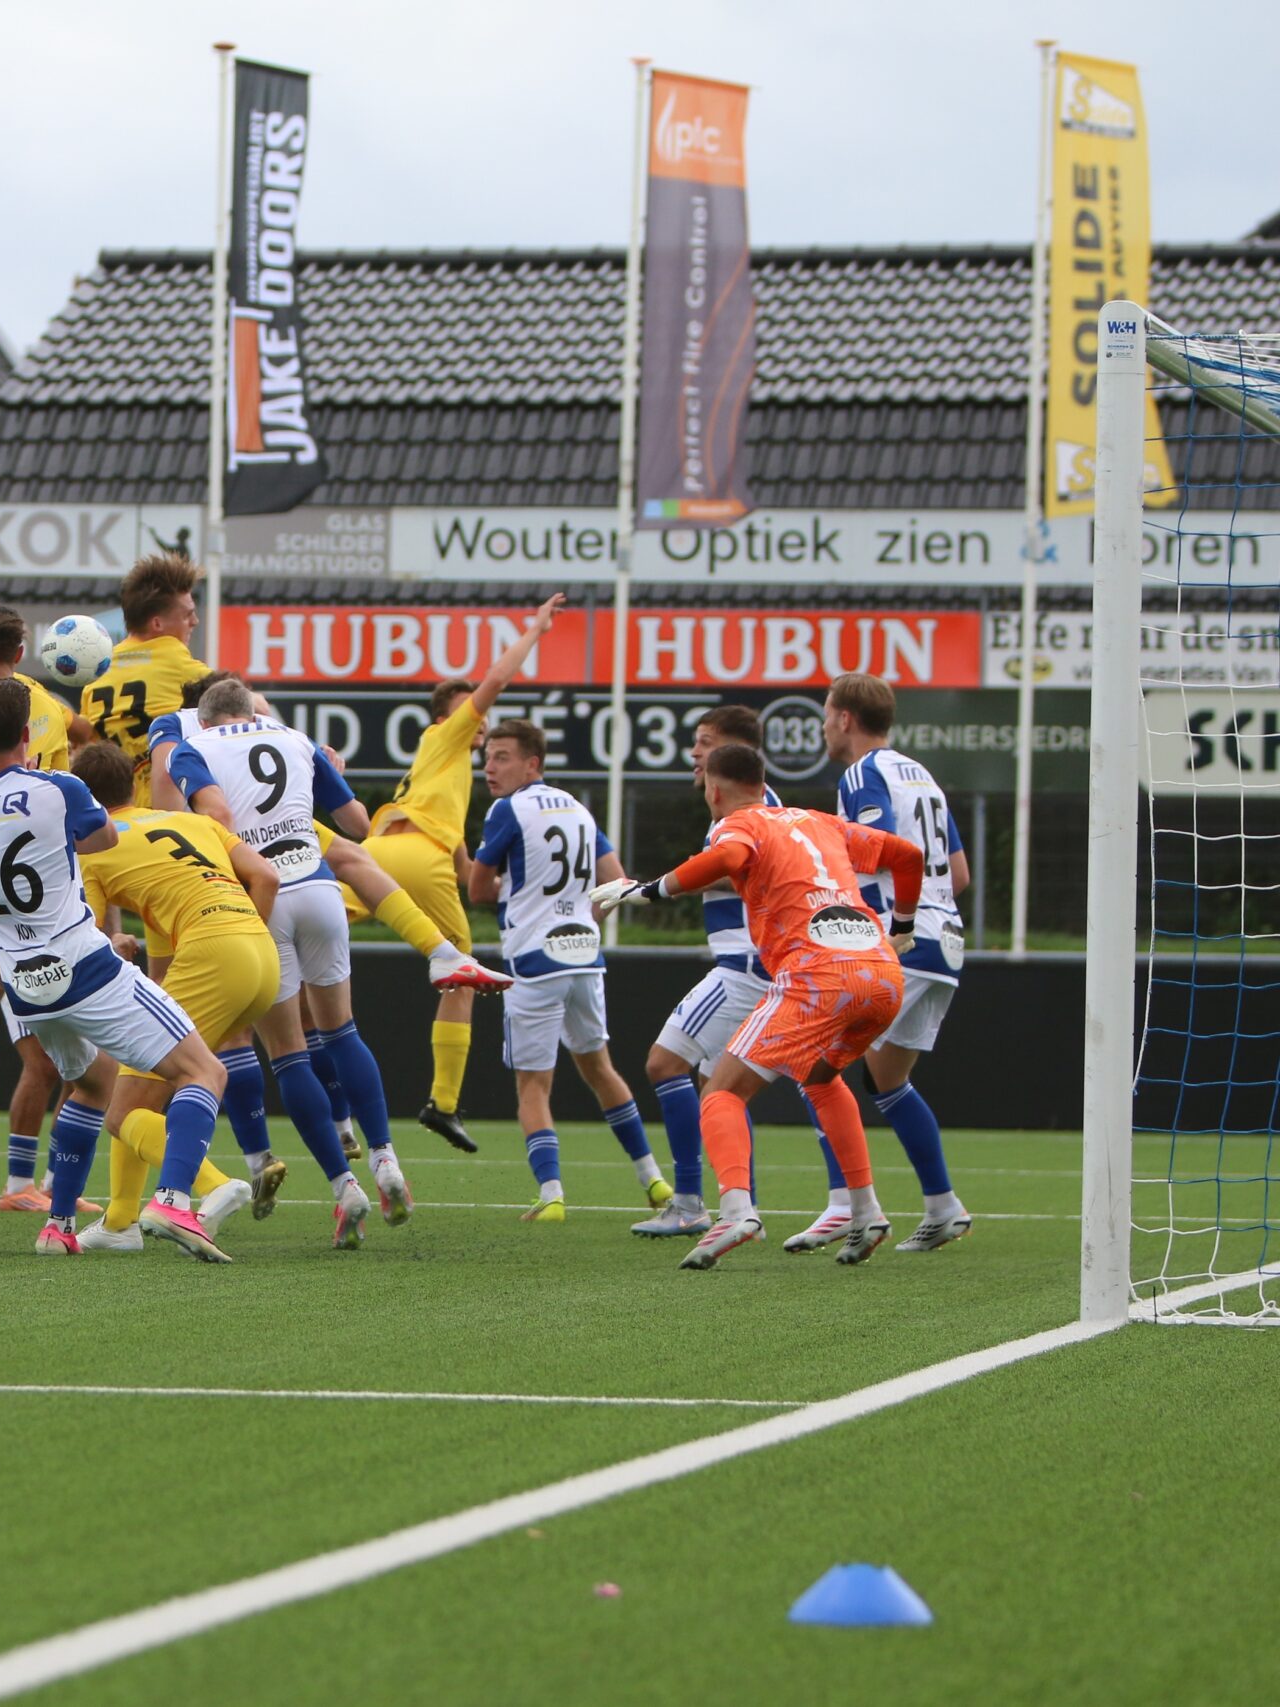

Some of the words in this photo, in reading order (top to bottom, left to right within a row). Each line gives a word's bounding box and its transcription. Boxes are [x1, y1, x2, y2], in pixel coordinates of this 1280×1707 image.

[259, 110, 307, 306] DOORS
[684, 195, 708, 310] Control
[1071, 161, 1105, 409] SOLIDE
[681, 320, 705, 376] Fire
[1107, 320, 1136, 335] W&H
[258, 325, 318, 465] JAKE
[275, 533, 386, 553] SCHILDER
[326, 513, 386, 532] GLAS
[662, 516, 843, 574] Optiek
[875, 518, 991, 565] zien
[220, 553, 386, 574] EHANGSTUDIO
[246, 611, 539, 679] HUBUN
[636, 615, 939, 683] HUBUN
[1181, 613, 1225, 652] de
[766, 715, 822, 753] 033
[248, 743, 288, 815] 9
[543, 823, 592, 896] 34
[789, 827, 841, 890] 1
[913, 795, 949, 878] 15
[56, 1152, 81, 1164] SVS
